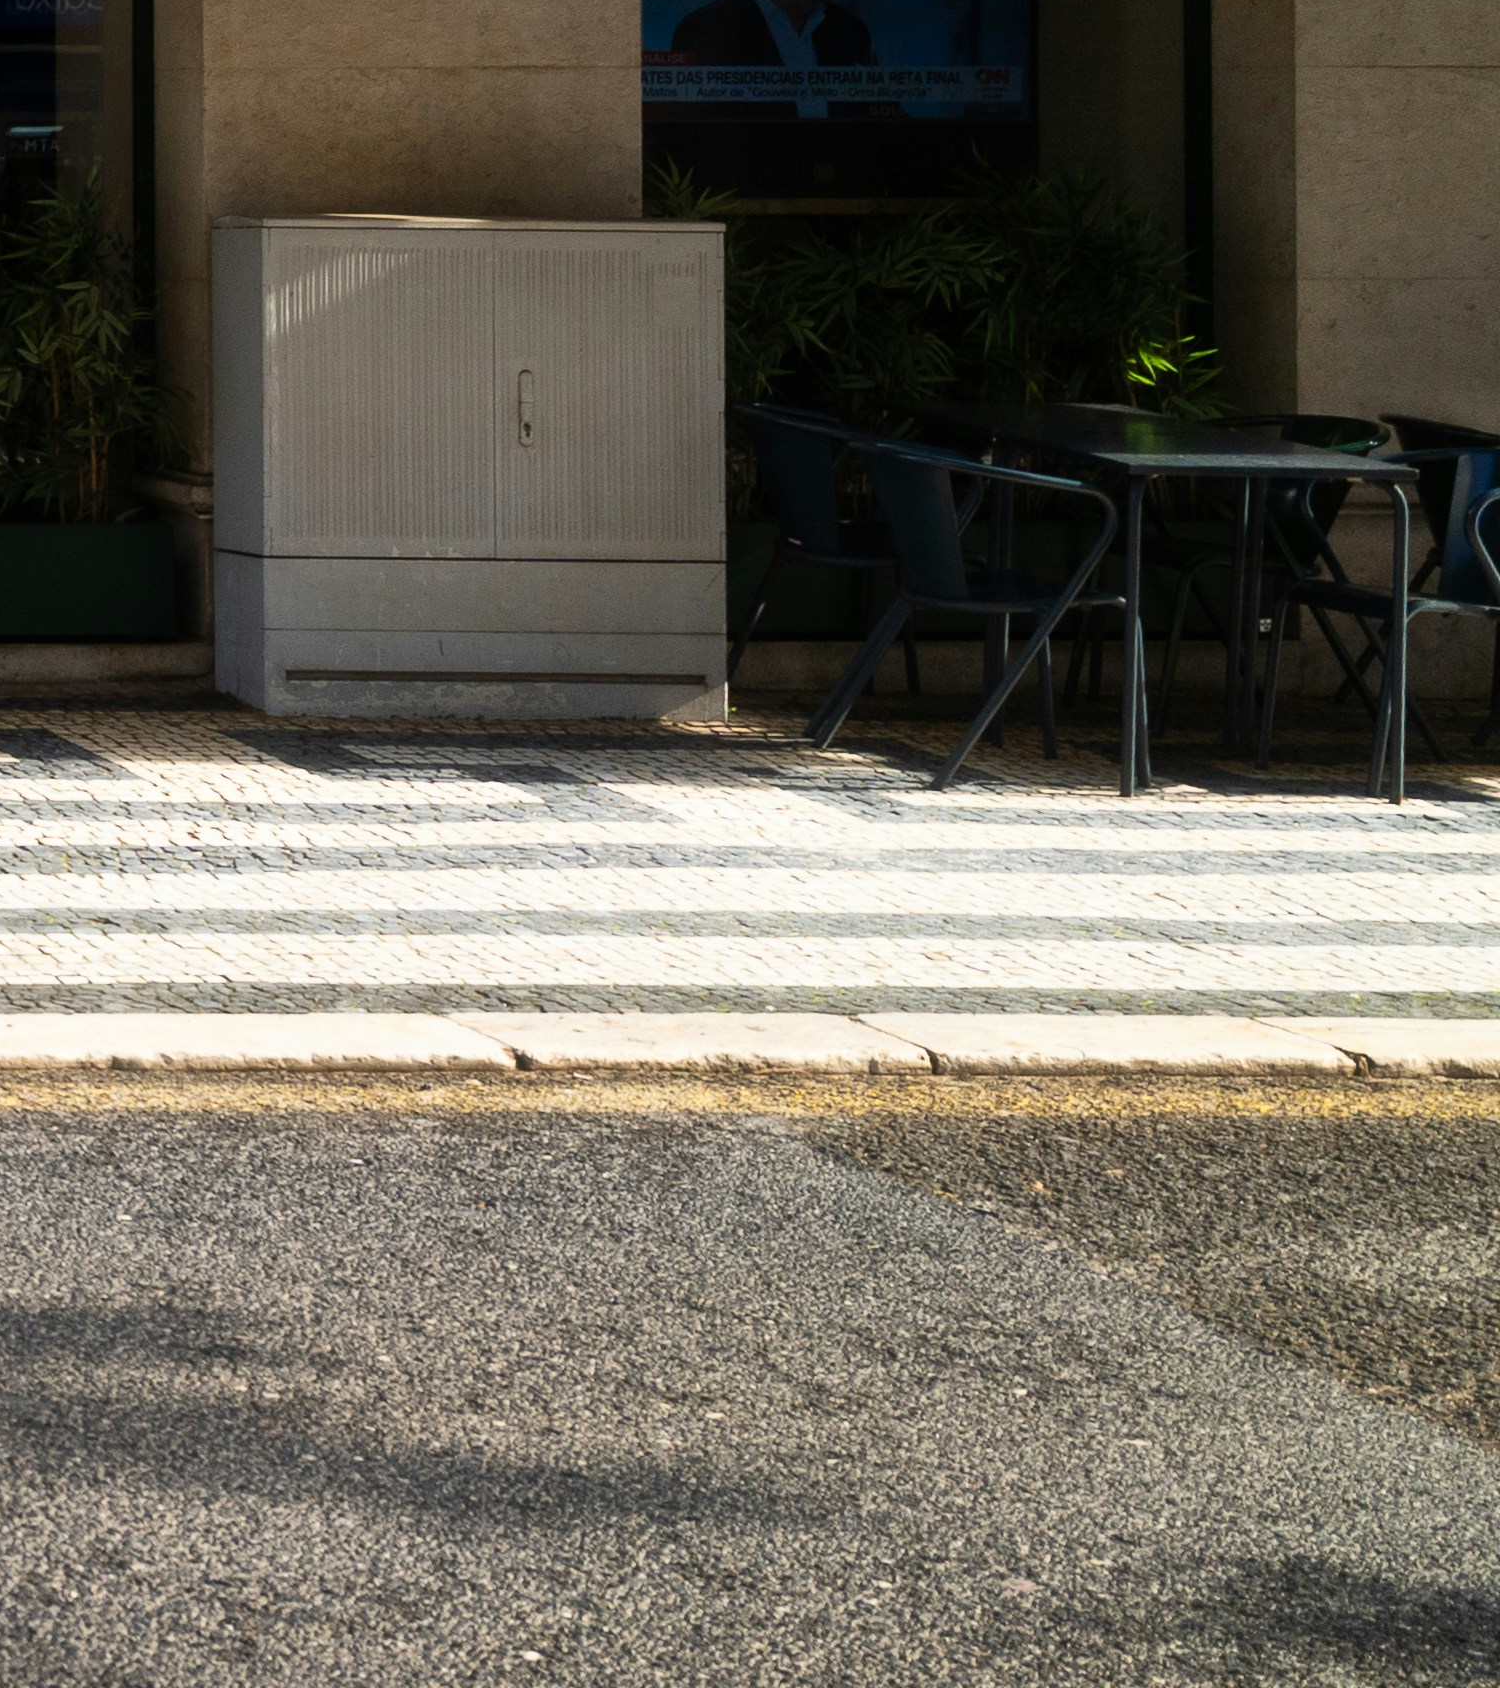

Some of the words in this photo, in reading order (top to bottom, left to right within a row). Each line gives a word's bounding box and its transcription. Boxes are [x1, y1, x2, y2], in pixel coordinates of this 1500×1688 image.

[677, 71, 703, 85] DAS
[707, 71, 804, 85] PRESIDENCIAIS
[808, 71, 862, 85] ENTRAM
[866, 71, 885, 85] NA
[975, 68, 1010, 85] CNN
[697, 87, 726, 97] Autor
[730, 87, 744, 97] de
